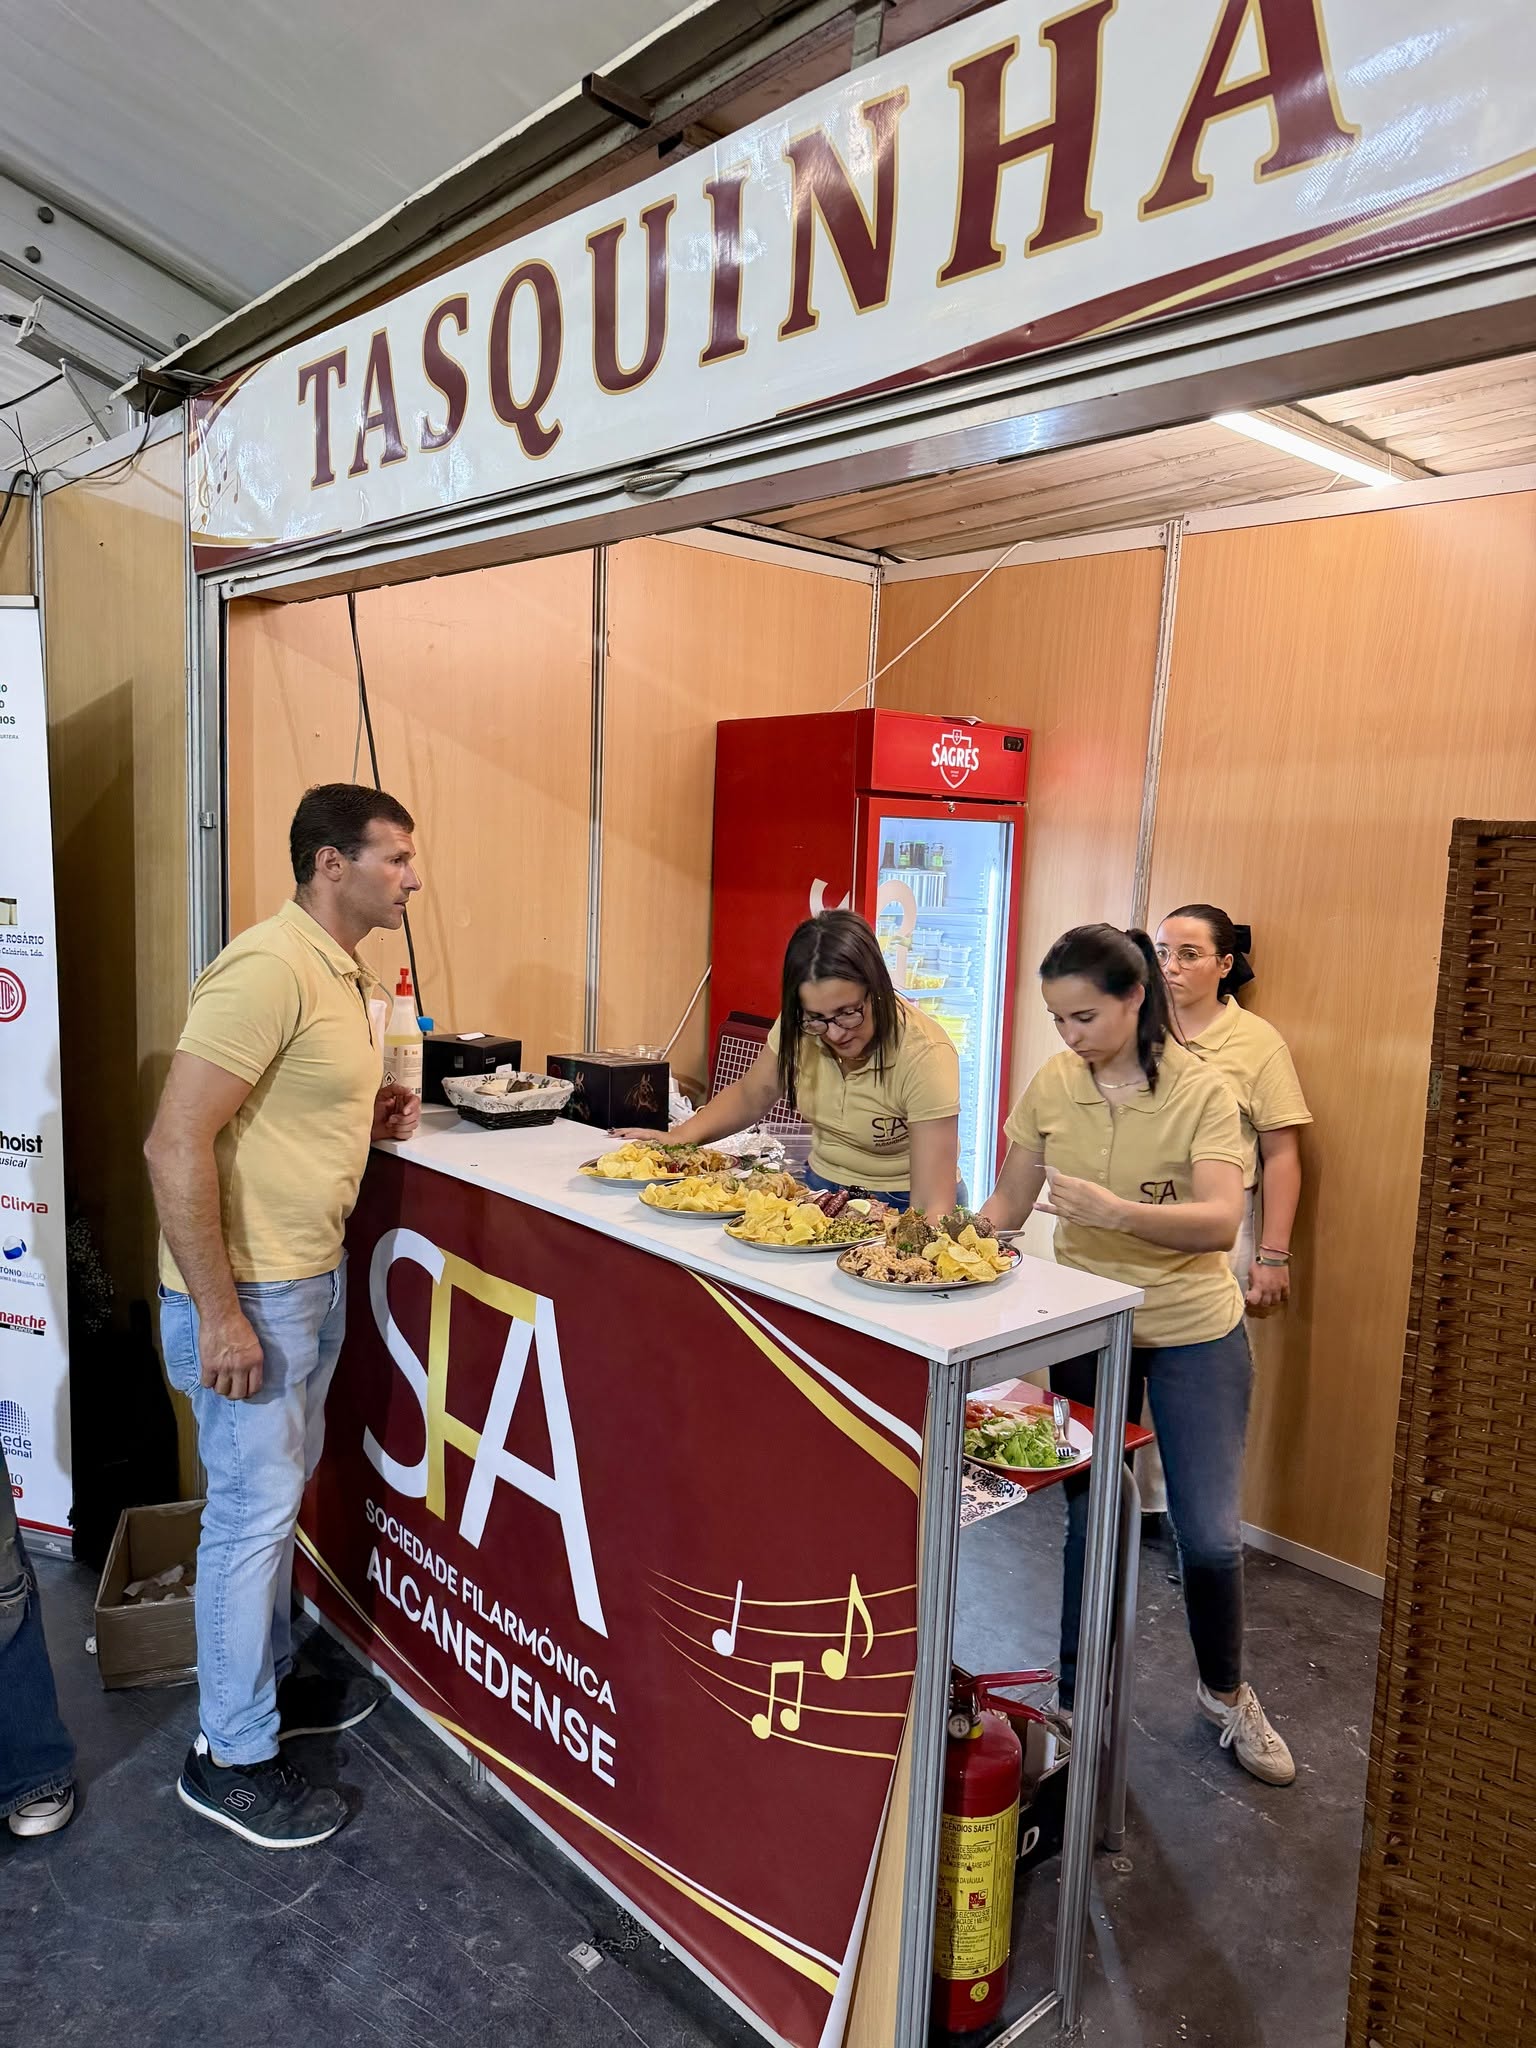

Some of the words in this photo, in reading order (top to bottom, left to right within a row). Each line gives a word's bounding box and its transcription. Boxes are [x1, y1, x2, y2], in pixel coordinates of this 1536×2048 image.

[298, 0, 1362, 489] TASQUINHA
[931, 743, 979, 771] SAGRES
[6, 931, 45, 945] ROSÁRIO
[0, 1130, 43, 1154] hoist
[365, 1498, 459, 1596] SOCIEDADE
[462, 1572, 617, 1714] FILARMÓNICA
[367, 1546, 617, 1787] ALCANEDENSE
[973, 1822, 996, 1833] SAFETY
